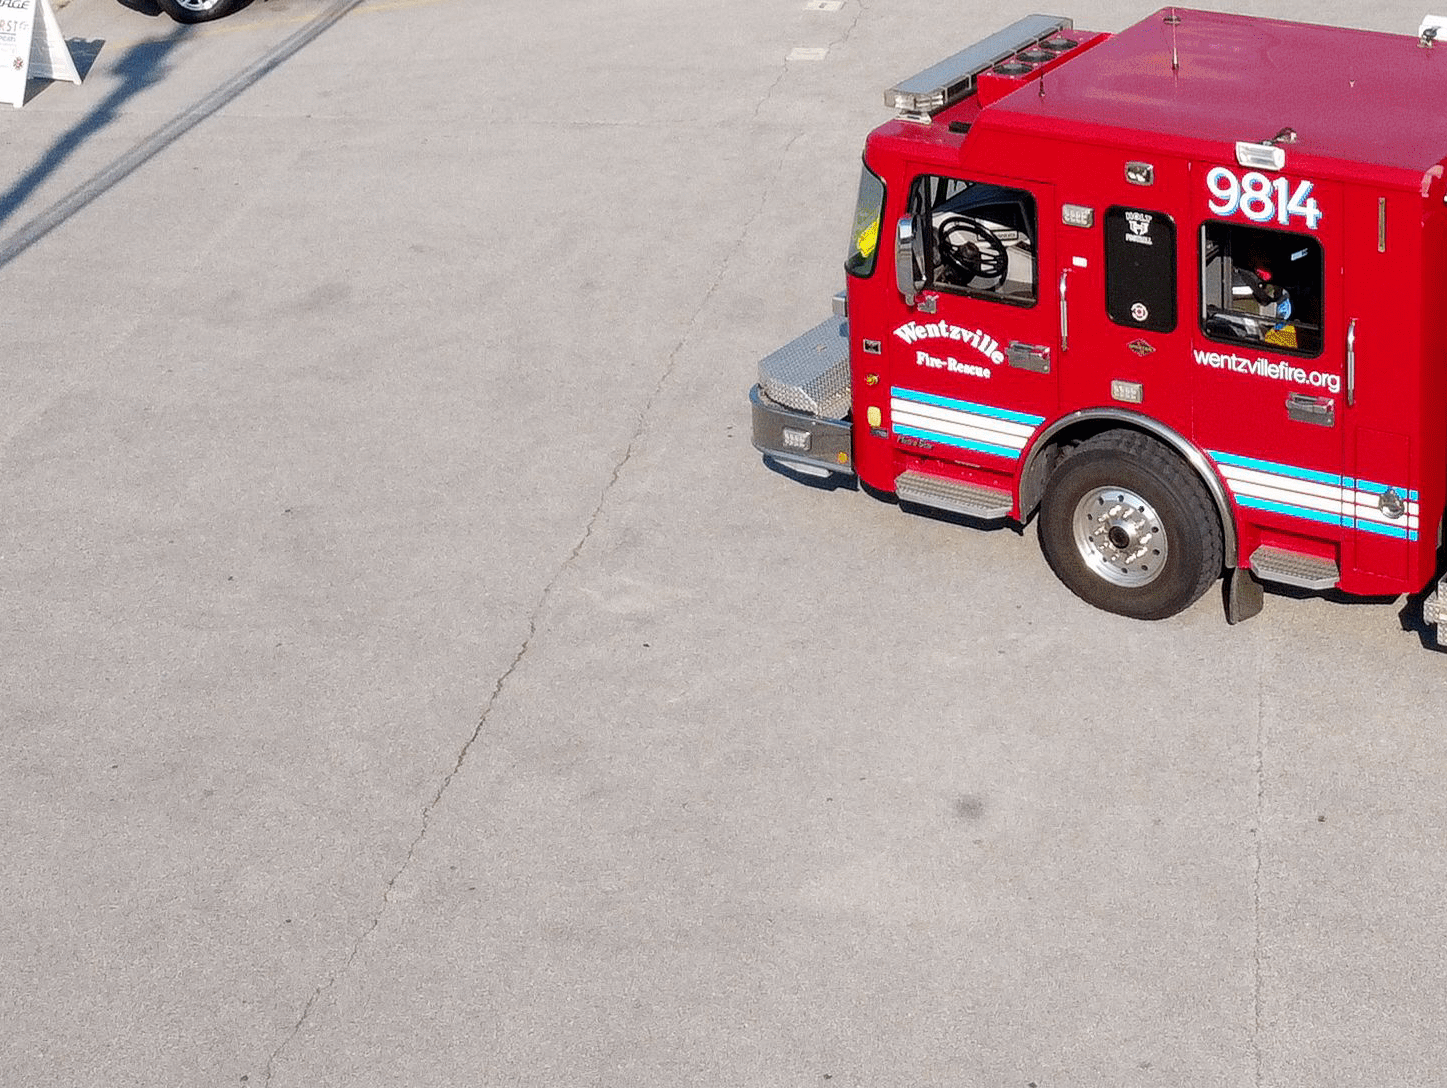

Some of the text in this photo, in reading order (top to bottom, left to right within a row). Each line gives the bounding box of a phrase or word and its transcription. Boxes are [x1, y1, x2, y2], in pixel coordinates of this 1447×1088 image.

[1206, 166, 1323, 230] 9814
[893, 319, 1004, 365] Wentzville
[916, 350, 991, 379] Fire-Rescue
[1193, 348, 1342, 393] wentzvillefire.org
